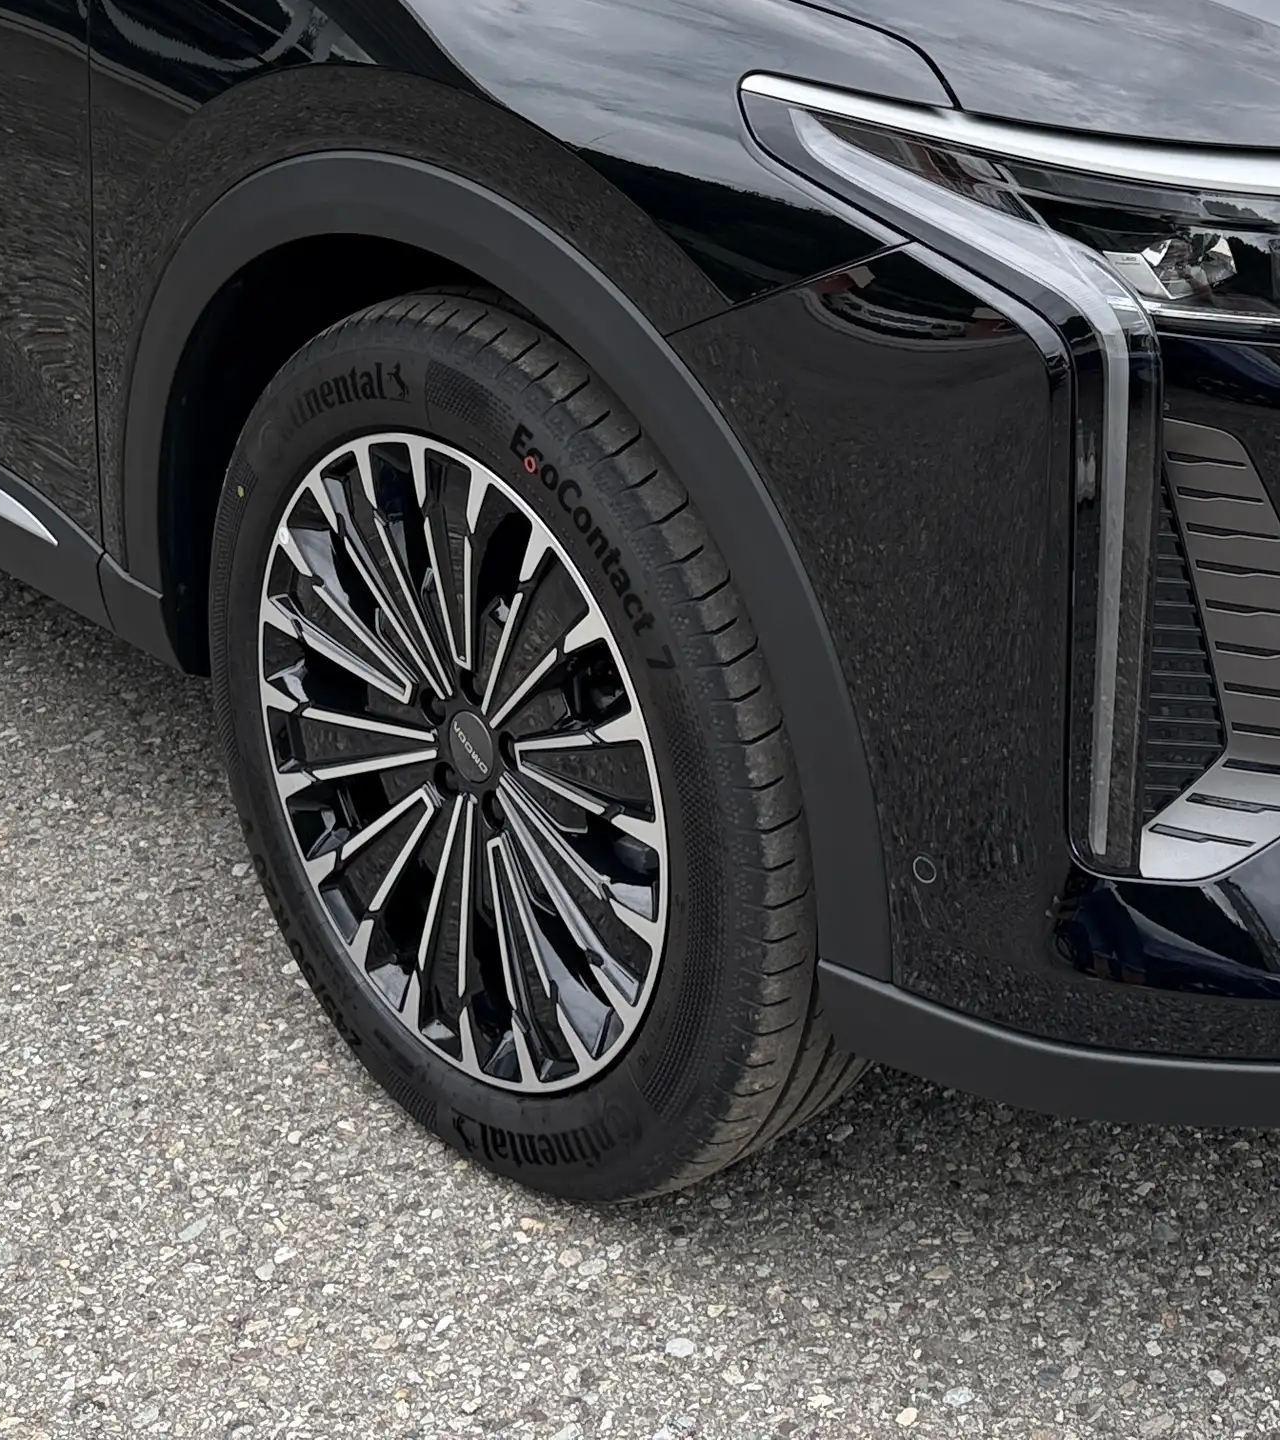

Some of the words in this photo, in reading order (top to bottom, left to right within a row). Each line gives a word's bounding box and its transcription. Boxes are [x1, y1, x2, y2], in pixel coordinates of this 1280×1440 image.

[509, 423, 656, 638] EcoContact
[645, 643, 677, 700] 7
[452, 720, 489, 775] OMODA
